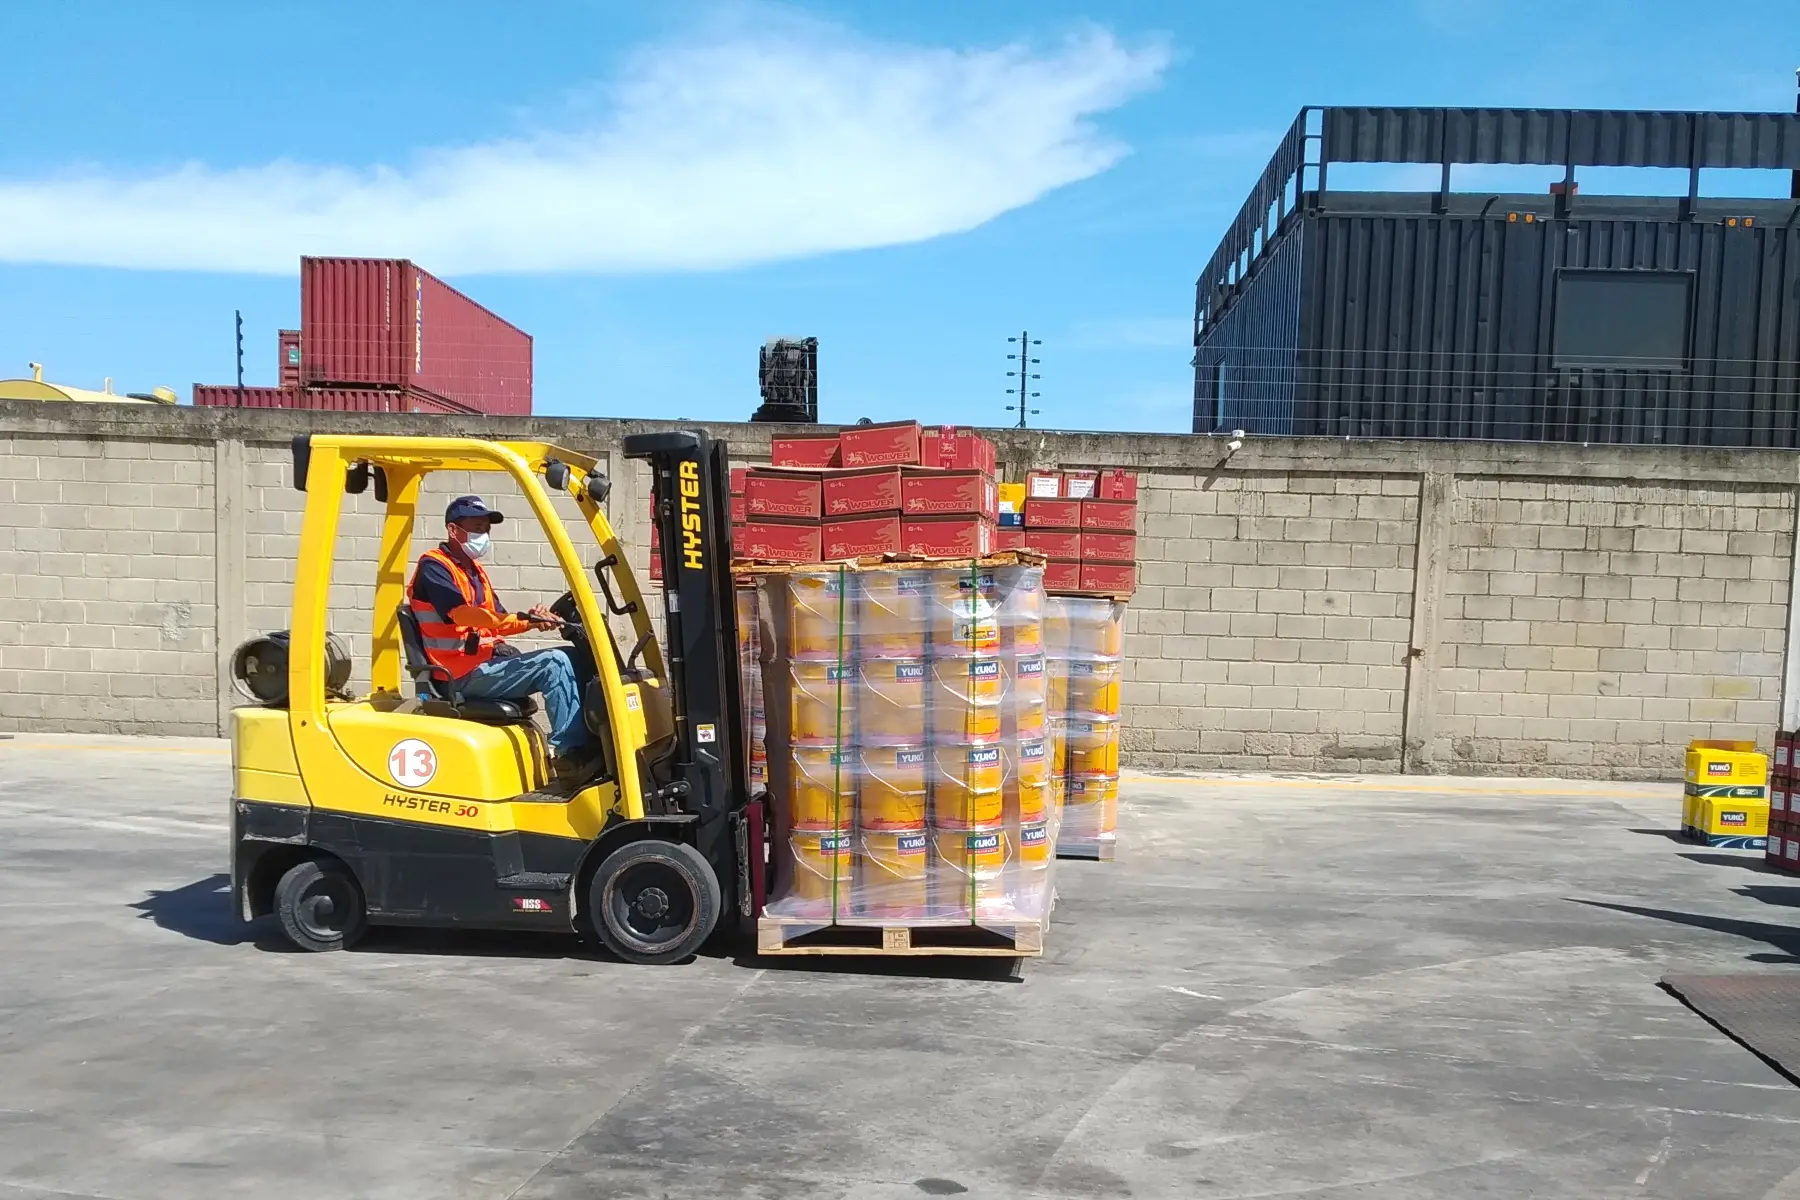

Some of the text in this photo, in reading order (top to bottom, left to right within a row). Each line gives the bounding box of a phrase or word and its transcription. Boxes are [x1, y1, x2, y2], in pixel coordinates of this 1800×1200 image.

[864, 451, 911, 463] WOLVER
[767, 501, 812, 514] WOLVER
[850, 499, 895, 510] WOLVER
[927, 500, 972, 510] WOLVER
[679, 460, 703, 569] HYSTER
[768, 548, 813, 559] WOLVER
[849, 543, 893, 554] WOLVER
[927, 546, 972, 556] WOLVER
[391, 749, 433, 777] 13
[383, 794, 479, 818] HYSTER 50
